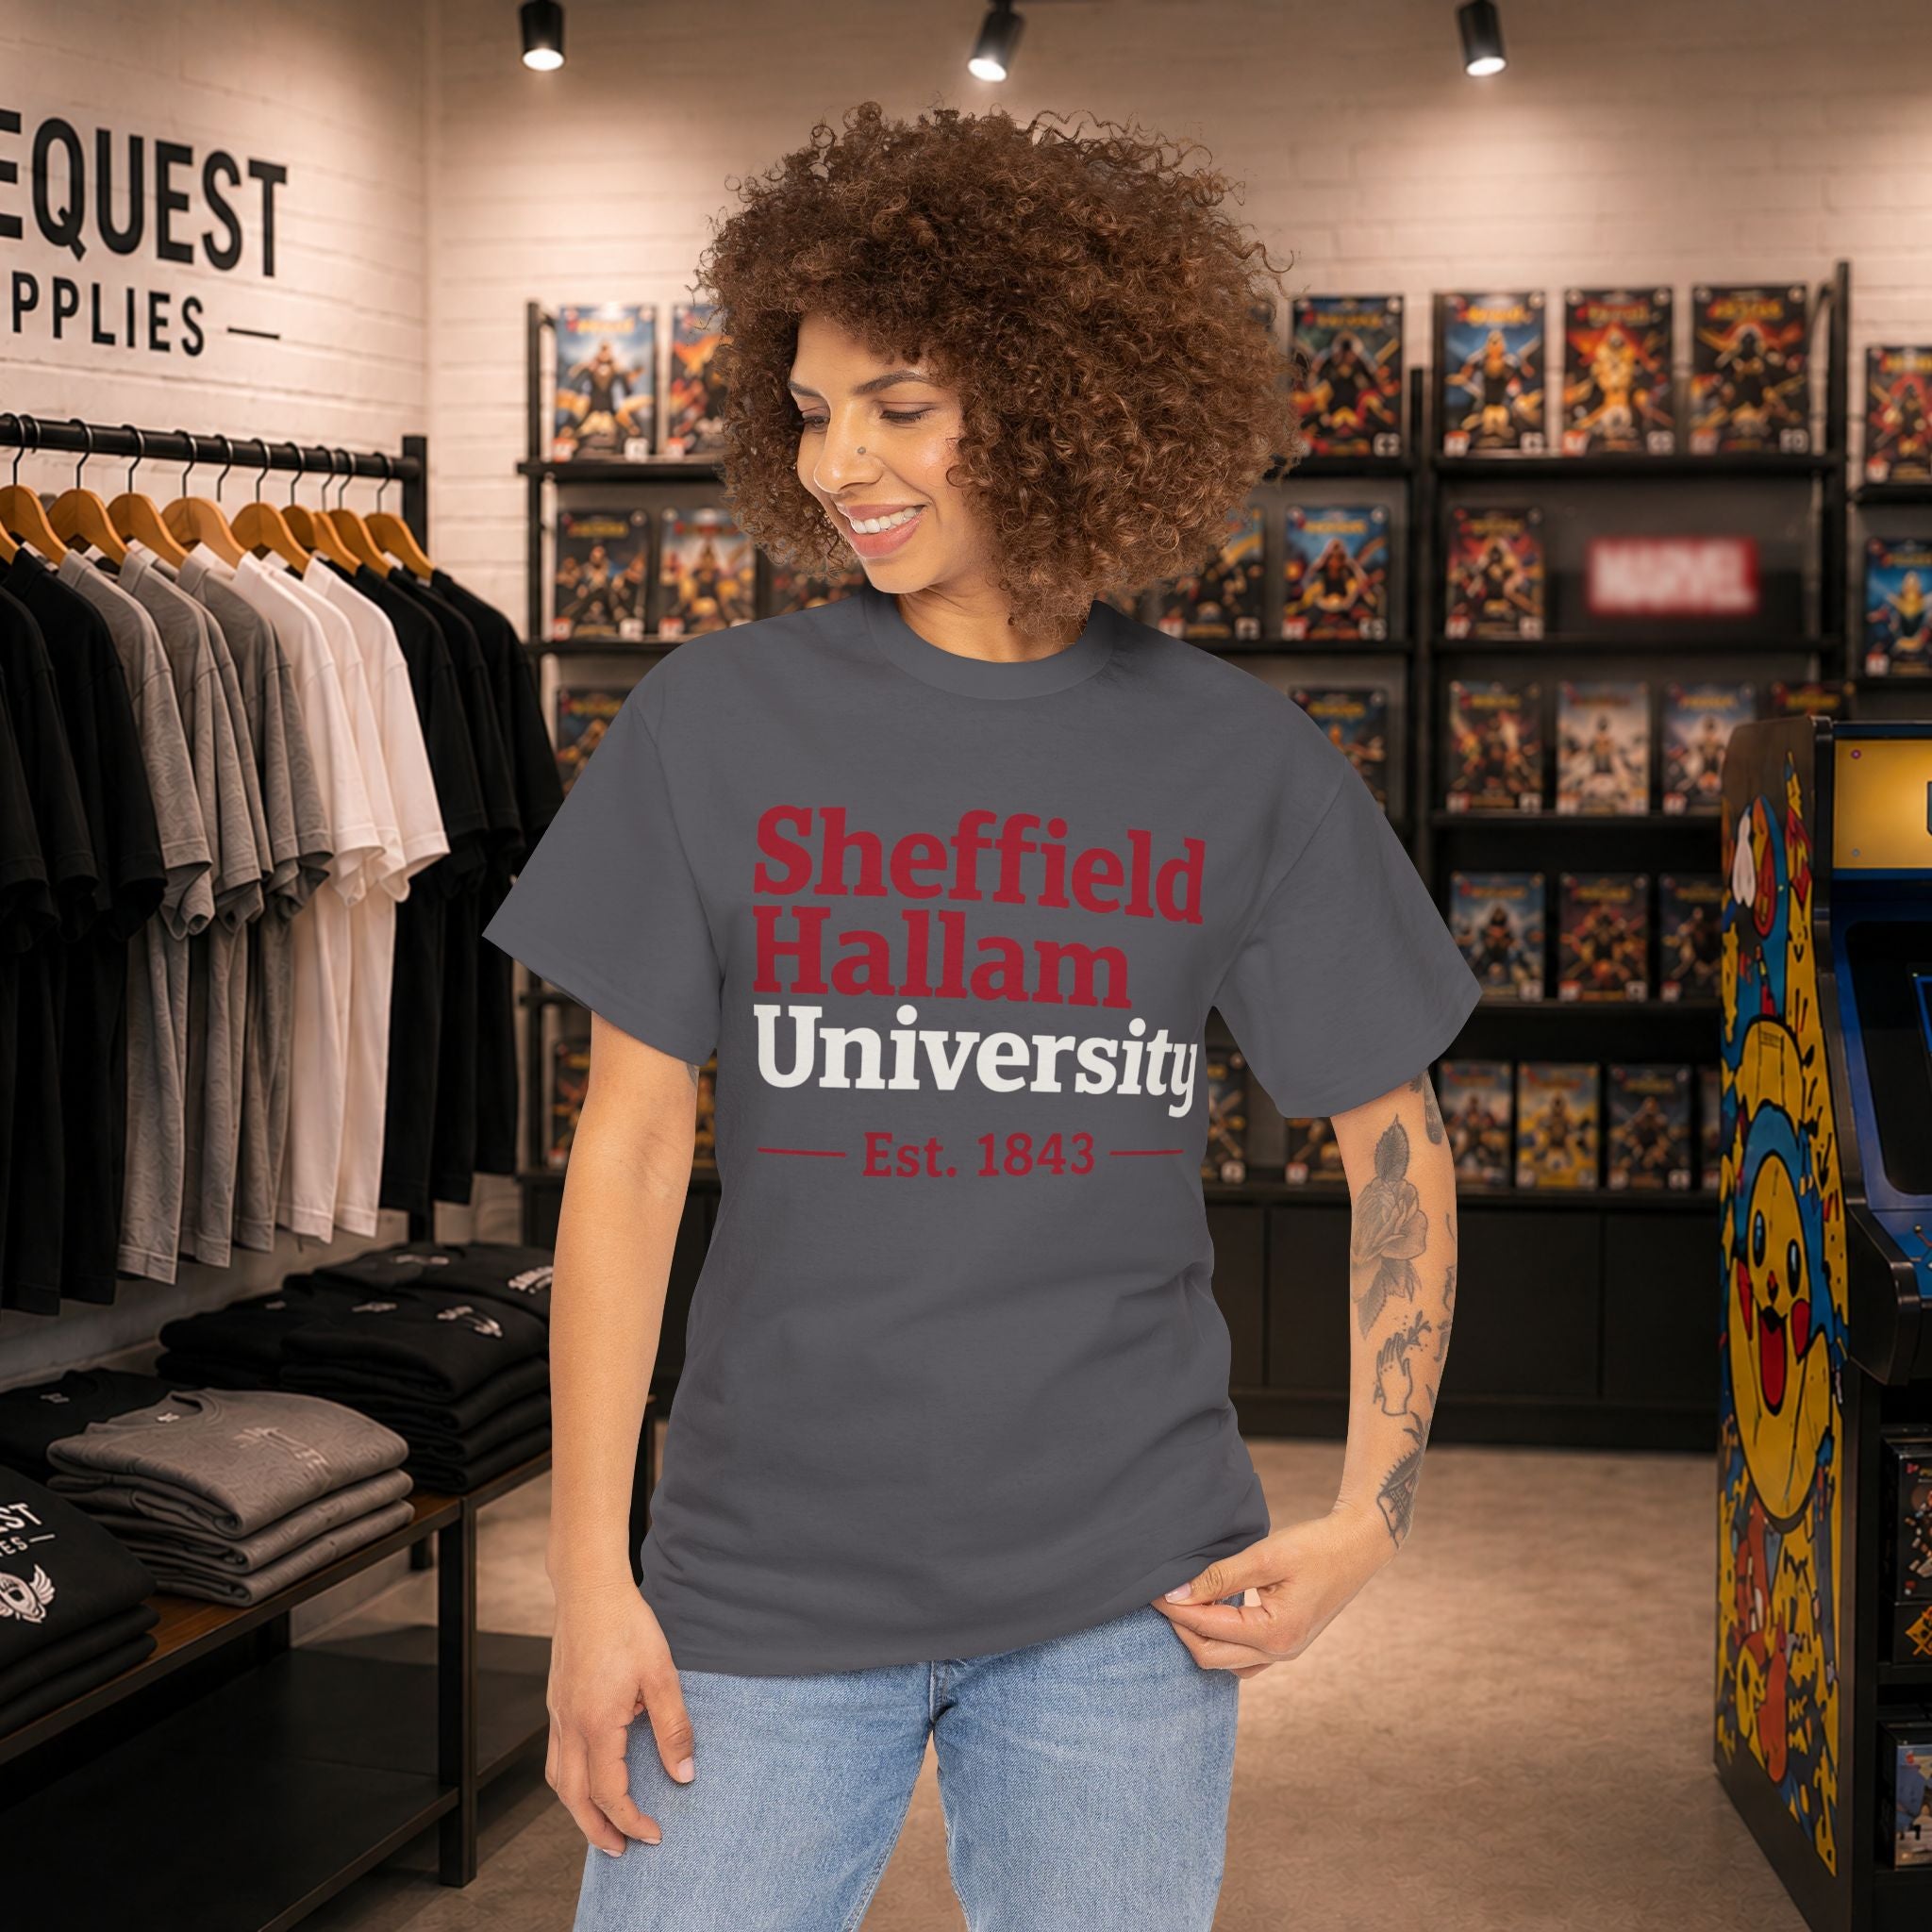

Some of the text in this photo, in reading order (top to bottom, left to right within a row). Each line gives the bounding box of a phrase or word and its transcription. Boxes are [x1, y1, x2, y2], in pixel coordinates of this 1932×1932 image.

[11, 270, 205, 358] PPLIES
[754, 805, 1206, 925] Sheffield
[753, 905, 1132, 1009] Hallam
[753, 1004, 1198, 1118] University
[862, 1131, 1095, 1178] Est. 1843
